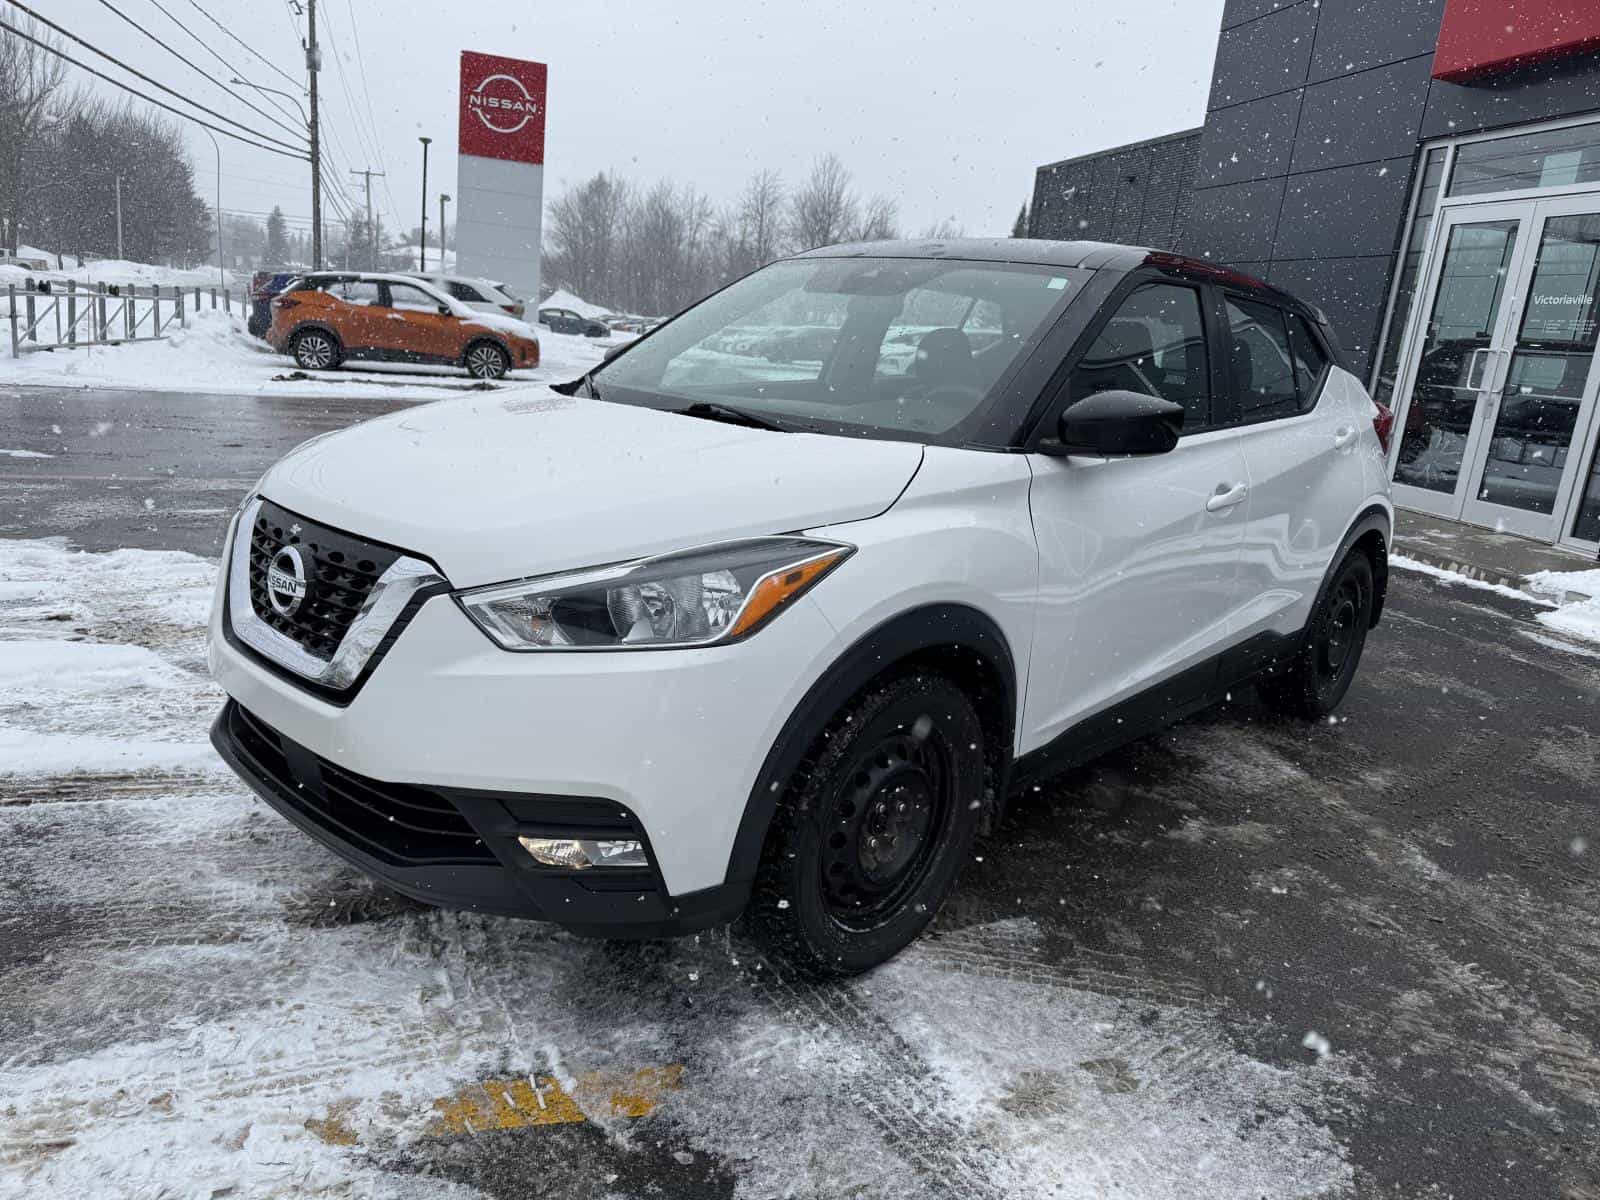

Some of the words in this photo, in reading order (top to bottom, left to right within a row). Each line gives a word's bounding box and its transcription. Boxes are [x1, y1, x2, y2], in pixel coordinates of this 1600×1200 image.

[469, 95, 537, 113] NISSAN
[1534, 294, 1593, 305] Victoriaville
[271, 575, 297, 594] SSAN
